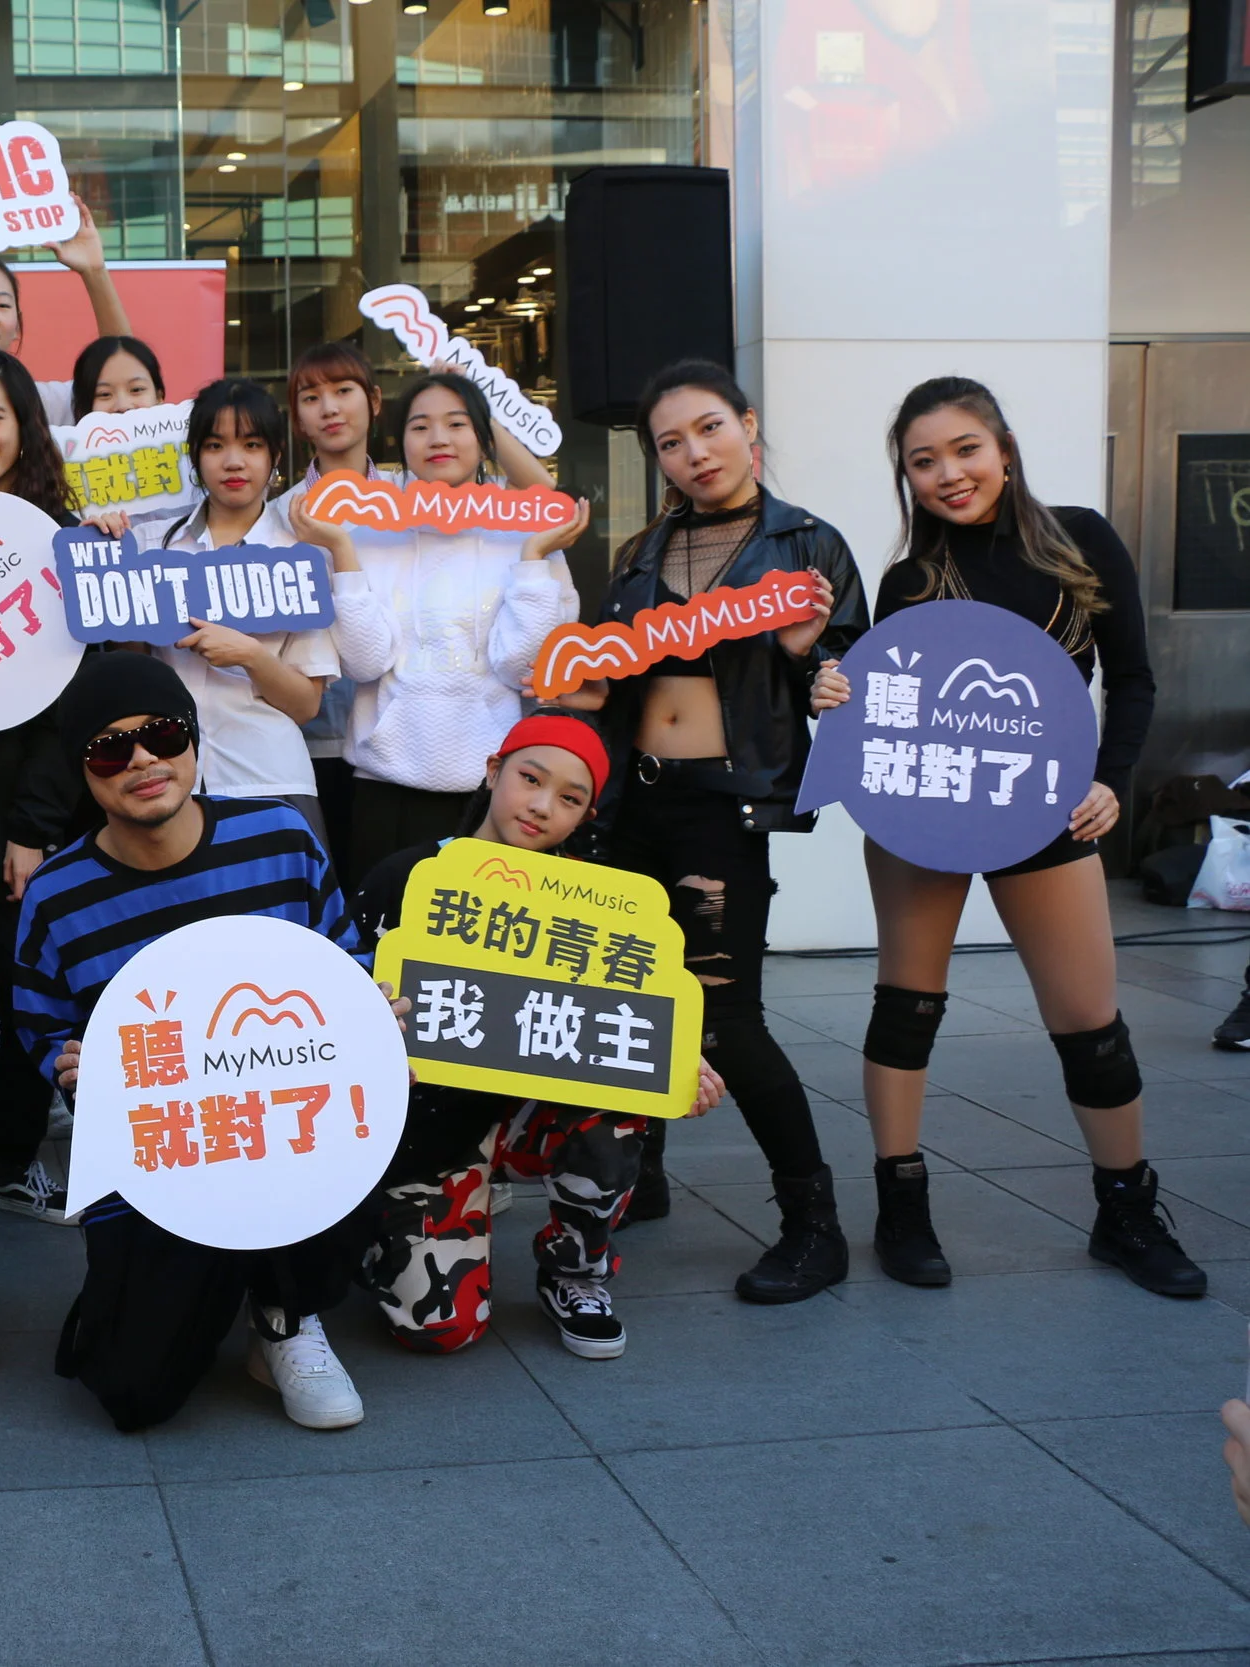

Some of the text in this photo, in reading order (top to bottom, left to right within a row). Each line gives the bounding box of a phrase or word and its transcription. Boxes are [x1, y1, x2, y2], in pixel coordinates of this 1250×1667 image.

[3, 205, 64, 232] STOP
[445, 346, 554, 448] MyMusic
[63, 442, 190, 511] 就對
[412, 491, 565, 523] MyMusic
[69, 541, 123, 567] WTF
[75, 560, 320, 628] DON'T JUDGE
[646, 584, 810, 651] MyMusic
[864, 671, 922, 729] 聽
[931, 707, 1043, 736] MyMusic
[539, 875, 638, 915] MyMusic
[426, 888, 657, 990] 我的青春
[118, 1019, 189, 1089] 聽
[203, 1038, 337, 1077] MyMusic
